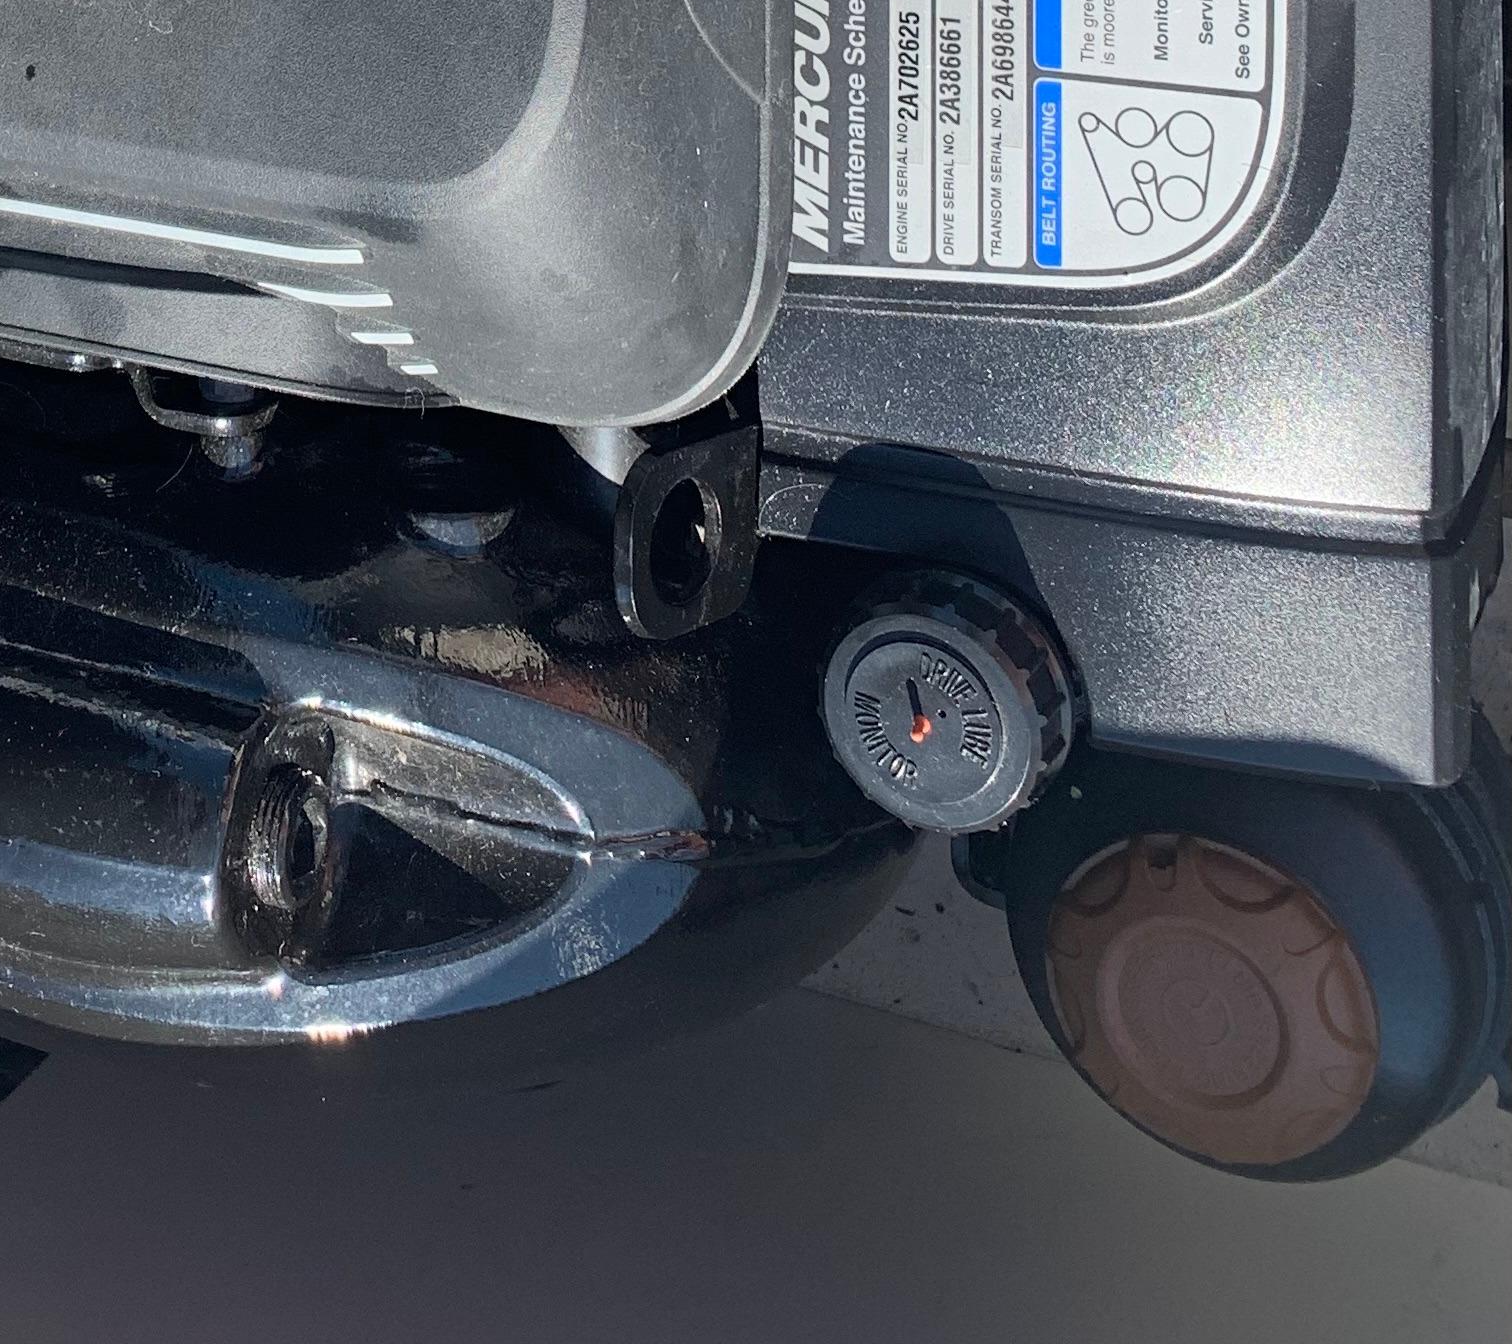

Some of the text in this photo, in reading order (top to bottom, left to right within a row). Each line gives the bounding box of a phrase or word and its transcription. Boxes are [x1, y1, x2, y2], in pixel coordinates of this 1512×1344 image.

[898, 12, 919, 121] 2A702625
[940, 18, 961, 125] 2A386661
[1235, 45, 1250, 79] See
[843, 74, 865, 245] Maintenance
[897, 148, 907, 197] SERIAL
[943, 159, 954, 209] SERIAL
[991, 133, 1002, 183] SERIAL
[1042, 103, 1056, 245] BELT ROUTING
[897, 202, 907, 253] ENGINE
[943, 213, 954, 255] DRIVE
[991, 187, 1002, 257] TRANSOM
[854, 691, 919, 787] MONITOR
[920, 652, 993, 770] DRIVE LUBE
